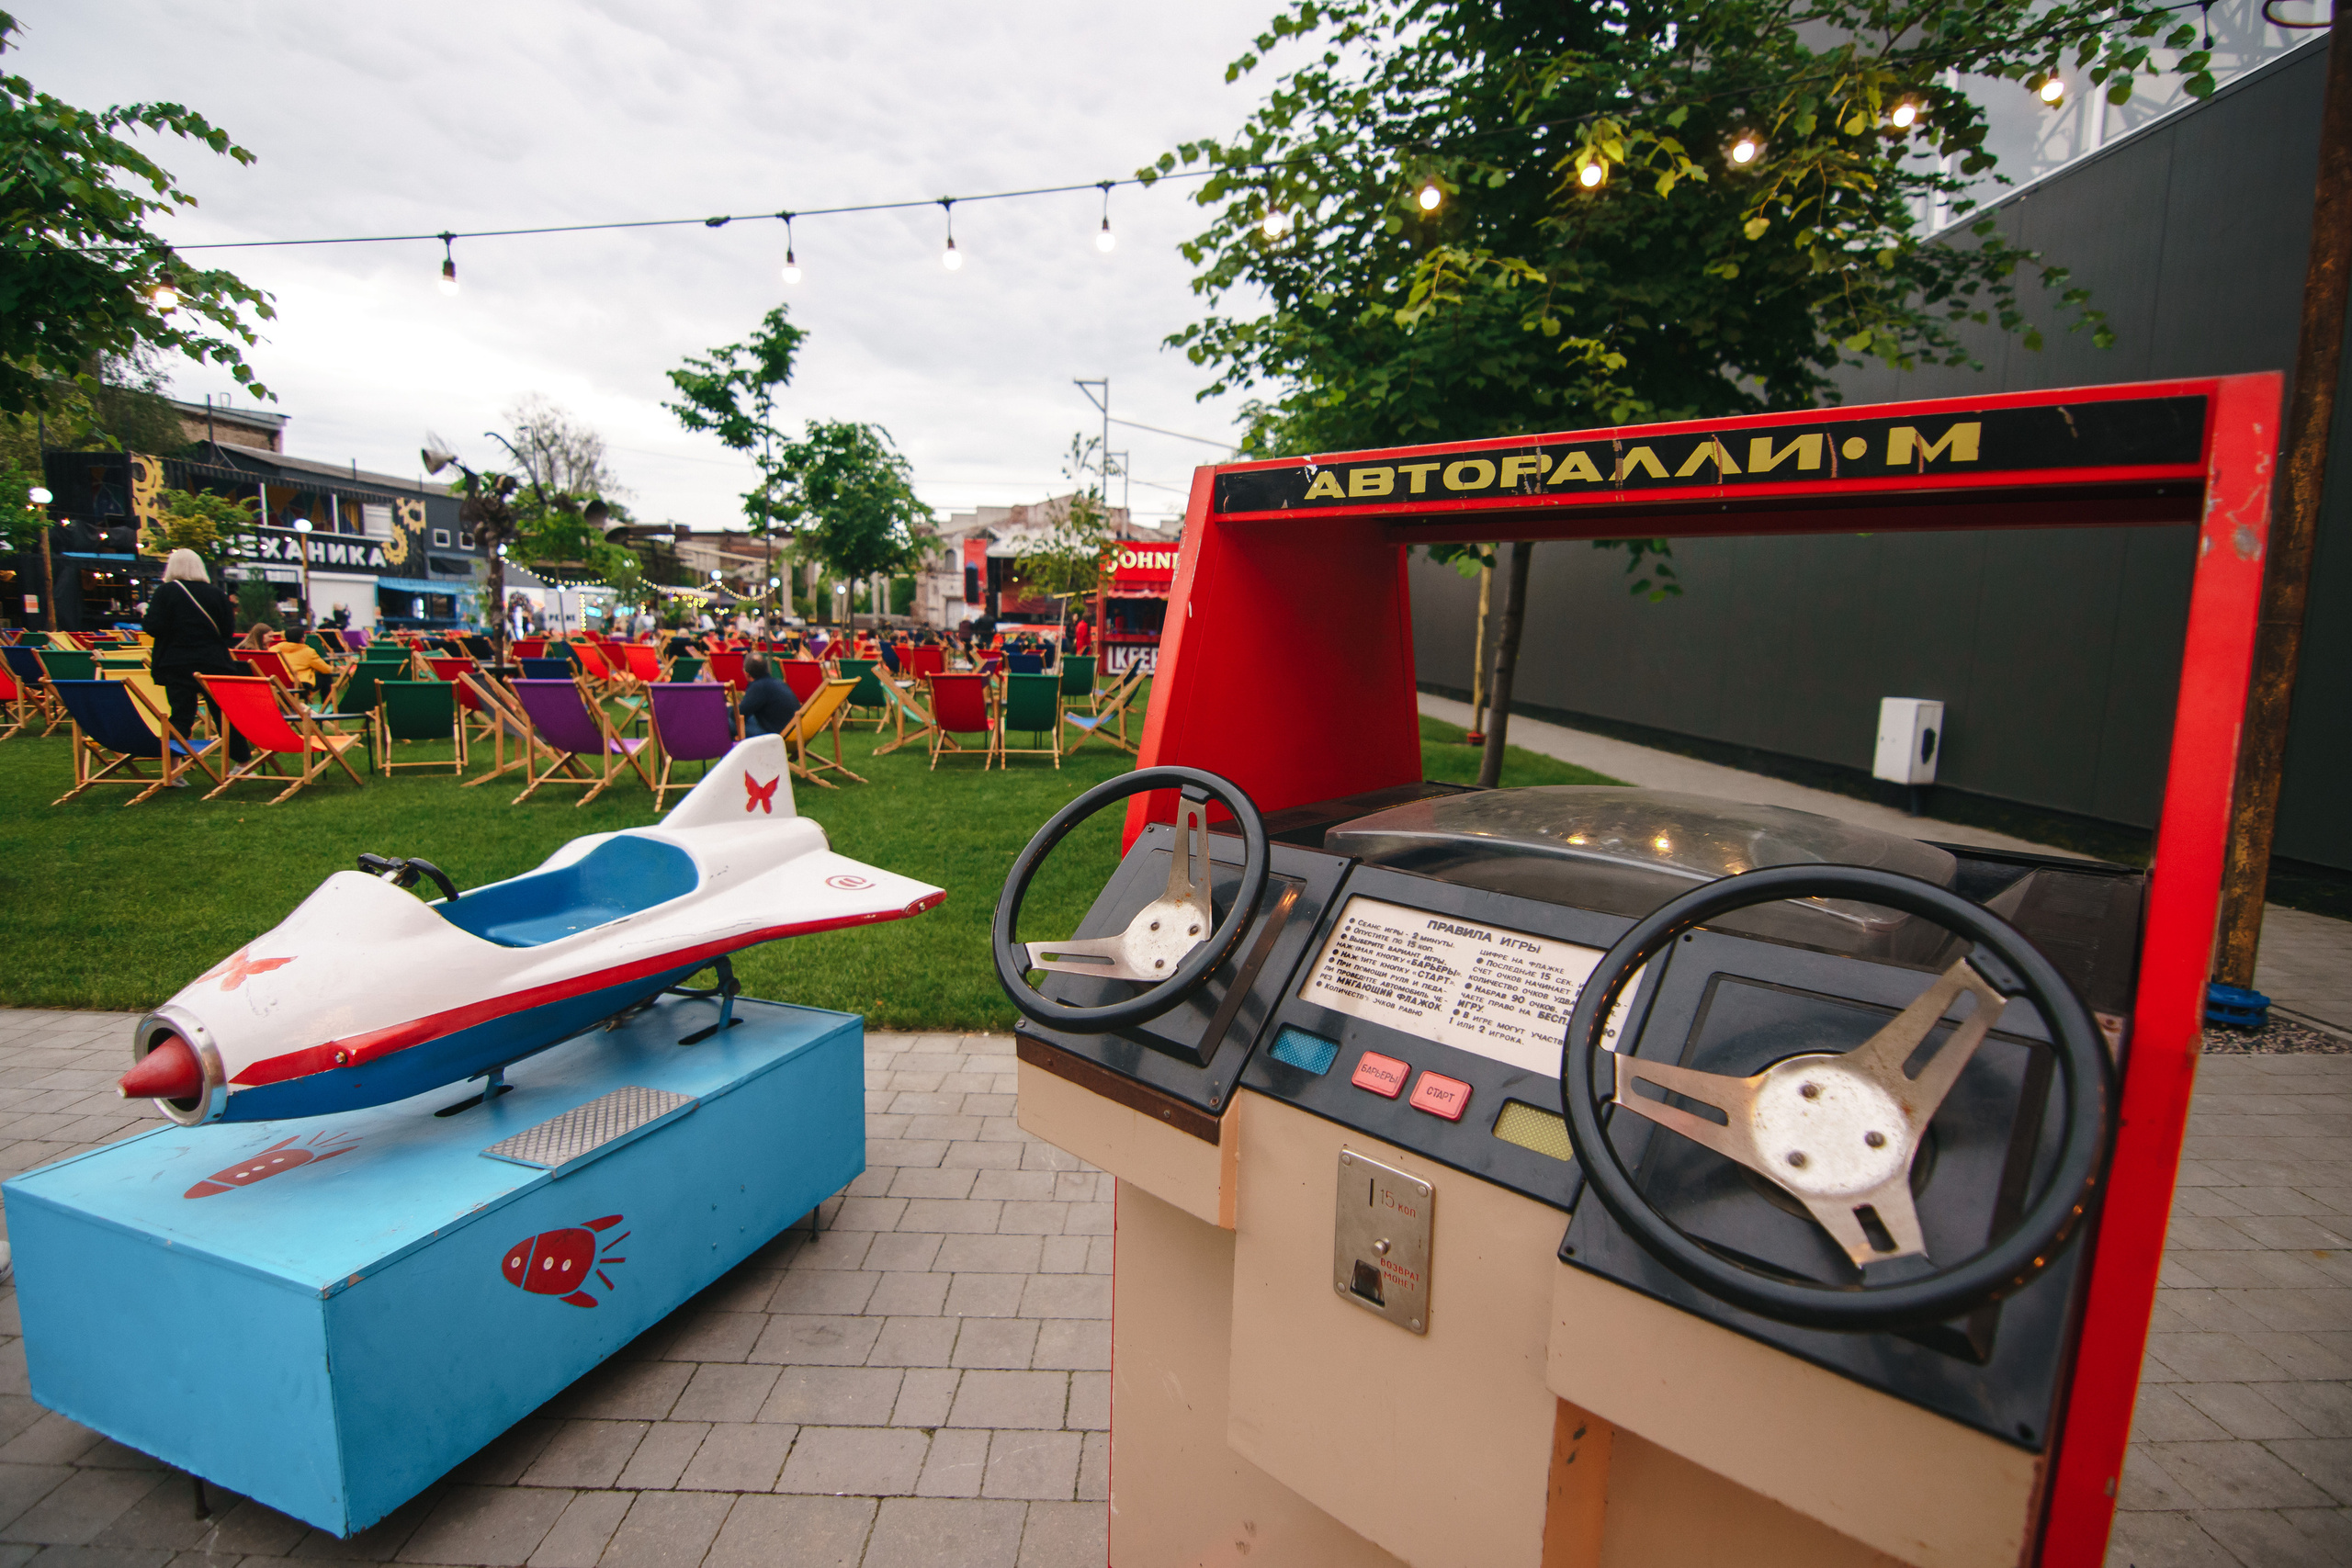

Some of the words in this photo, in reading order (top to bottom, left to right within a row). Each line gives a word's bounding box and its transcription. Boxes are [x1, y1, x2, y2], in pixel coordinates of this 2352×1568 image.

[1353, 927, 1389, 942] ОПУСТИТЕ
[1392, 937, 1403, 945] ПО
[1407, 940, 1417, 949] 15
[1418, 944, 1434, 953] КОП.
[1357, 919, 1382, 931] СЕАНС
[1384, 926, 1404, 936] ИГРЫ
[1411, 931, 1419, 941] 2
[1419, 935, 1455, 949] МИНУТЫ.
[1427, 919, 1492, 942] ПРАВИЛА
[1499, 936, 1542, 954] ИГРЫ
[1349, 934, 1386, 950] ВЫБЕРИТЕ
[1387, 945, 1421, 959] ВАРИАНТ
[1423, 954, 1447, 966] ИГРЫ.
[1375, 952, 1406, 964] КНОПКУ
[1479, 949, 1509, 962] ЦИФРЕ
[1510, 956, 1524, 964] НА
[1528, 961, 1565, 975] ФЛАЖКЕ
[1323, 964, 1335, 974] ЛИ
[1379, 980, 1430, 999] АВТОМОБИЛЬ
[1336, 958, 1352, 968] ПРИ
[1353, 964, 1388, 979] ПОМОЩИ
[1389, 974, 1409, 985] РУЛЯ
[1379, 962, 1410, 975] КНОПКУ
[1472, 965, 1493, 976] СЧЕТ
[1496, 972, 1522, 983] ОЧКОВ
[1524, 979, 1572, 996] НАЧИНАЕТ
[1486, 959, 1537, 978] ПОСЛЕДНИЕ
[1540, 972, 1551, 981] 15
[1555, 977, 1574, 987] СЕК.
[1319, 973, 1333, 982] РЕЗ
[1336, 976, 1394, 998] МИГАЮЩИЙ
[1396, 992, 1443, 1012] ФЛАЖОК.
[1467, 974, 1519, 992] КОЛИЧЕСТВО
[1521, 987, 1549, 1000] ОЧКОВ
[1474, 985, 1508, 999] НАБРАВ
[1511, 994, 1525, 1004] 90
[1397, 1005, 1423, 1017] РАВНО
[1457, 998, 1485, 1013] ИГРУ.
[1461, 991, 1485, 1004] ЧАЕТЕ
[1487, 999, 1515, 1011] ПРАВО
[1519, 1008, 1531, 1016] НА
[1449, 1016, 1454, 1024] 1
[1456, 1021, 1476, 1031] ИЛИ
[1478, 1025, 1487, 1033] 2
[1487, 1030, 1525, 1045] ИГРОКА.
[1463, 1010, 1470, 1019] В
[1472, 1015, 1494, 1026] ИГРЕ
[1496, 1021, 1526, 1035] МОГУТ
[1531, 1031, 1564, 1046] УЧАСТВ
[1361, 1063, 1400, 1084] БАРЬЕРЫ
[1426, 1086, 1456, 1103] СТАРТ
[1380, 1189, 1395, 1209] 15
[1380, 1258, 1420, 1282] ВОЗВРАТ
[1384, 1270, 1415, 1292] МОНЕТ
